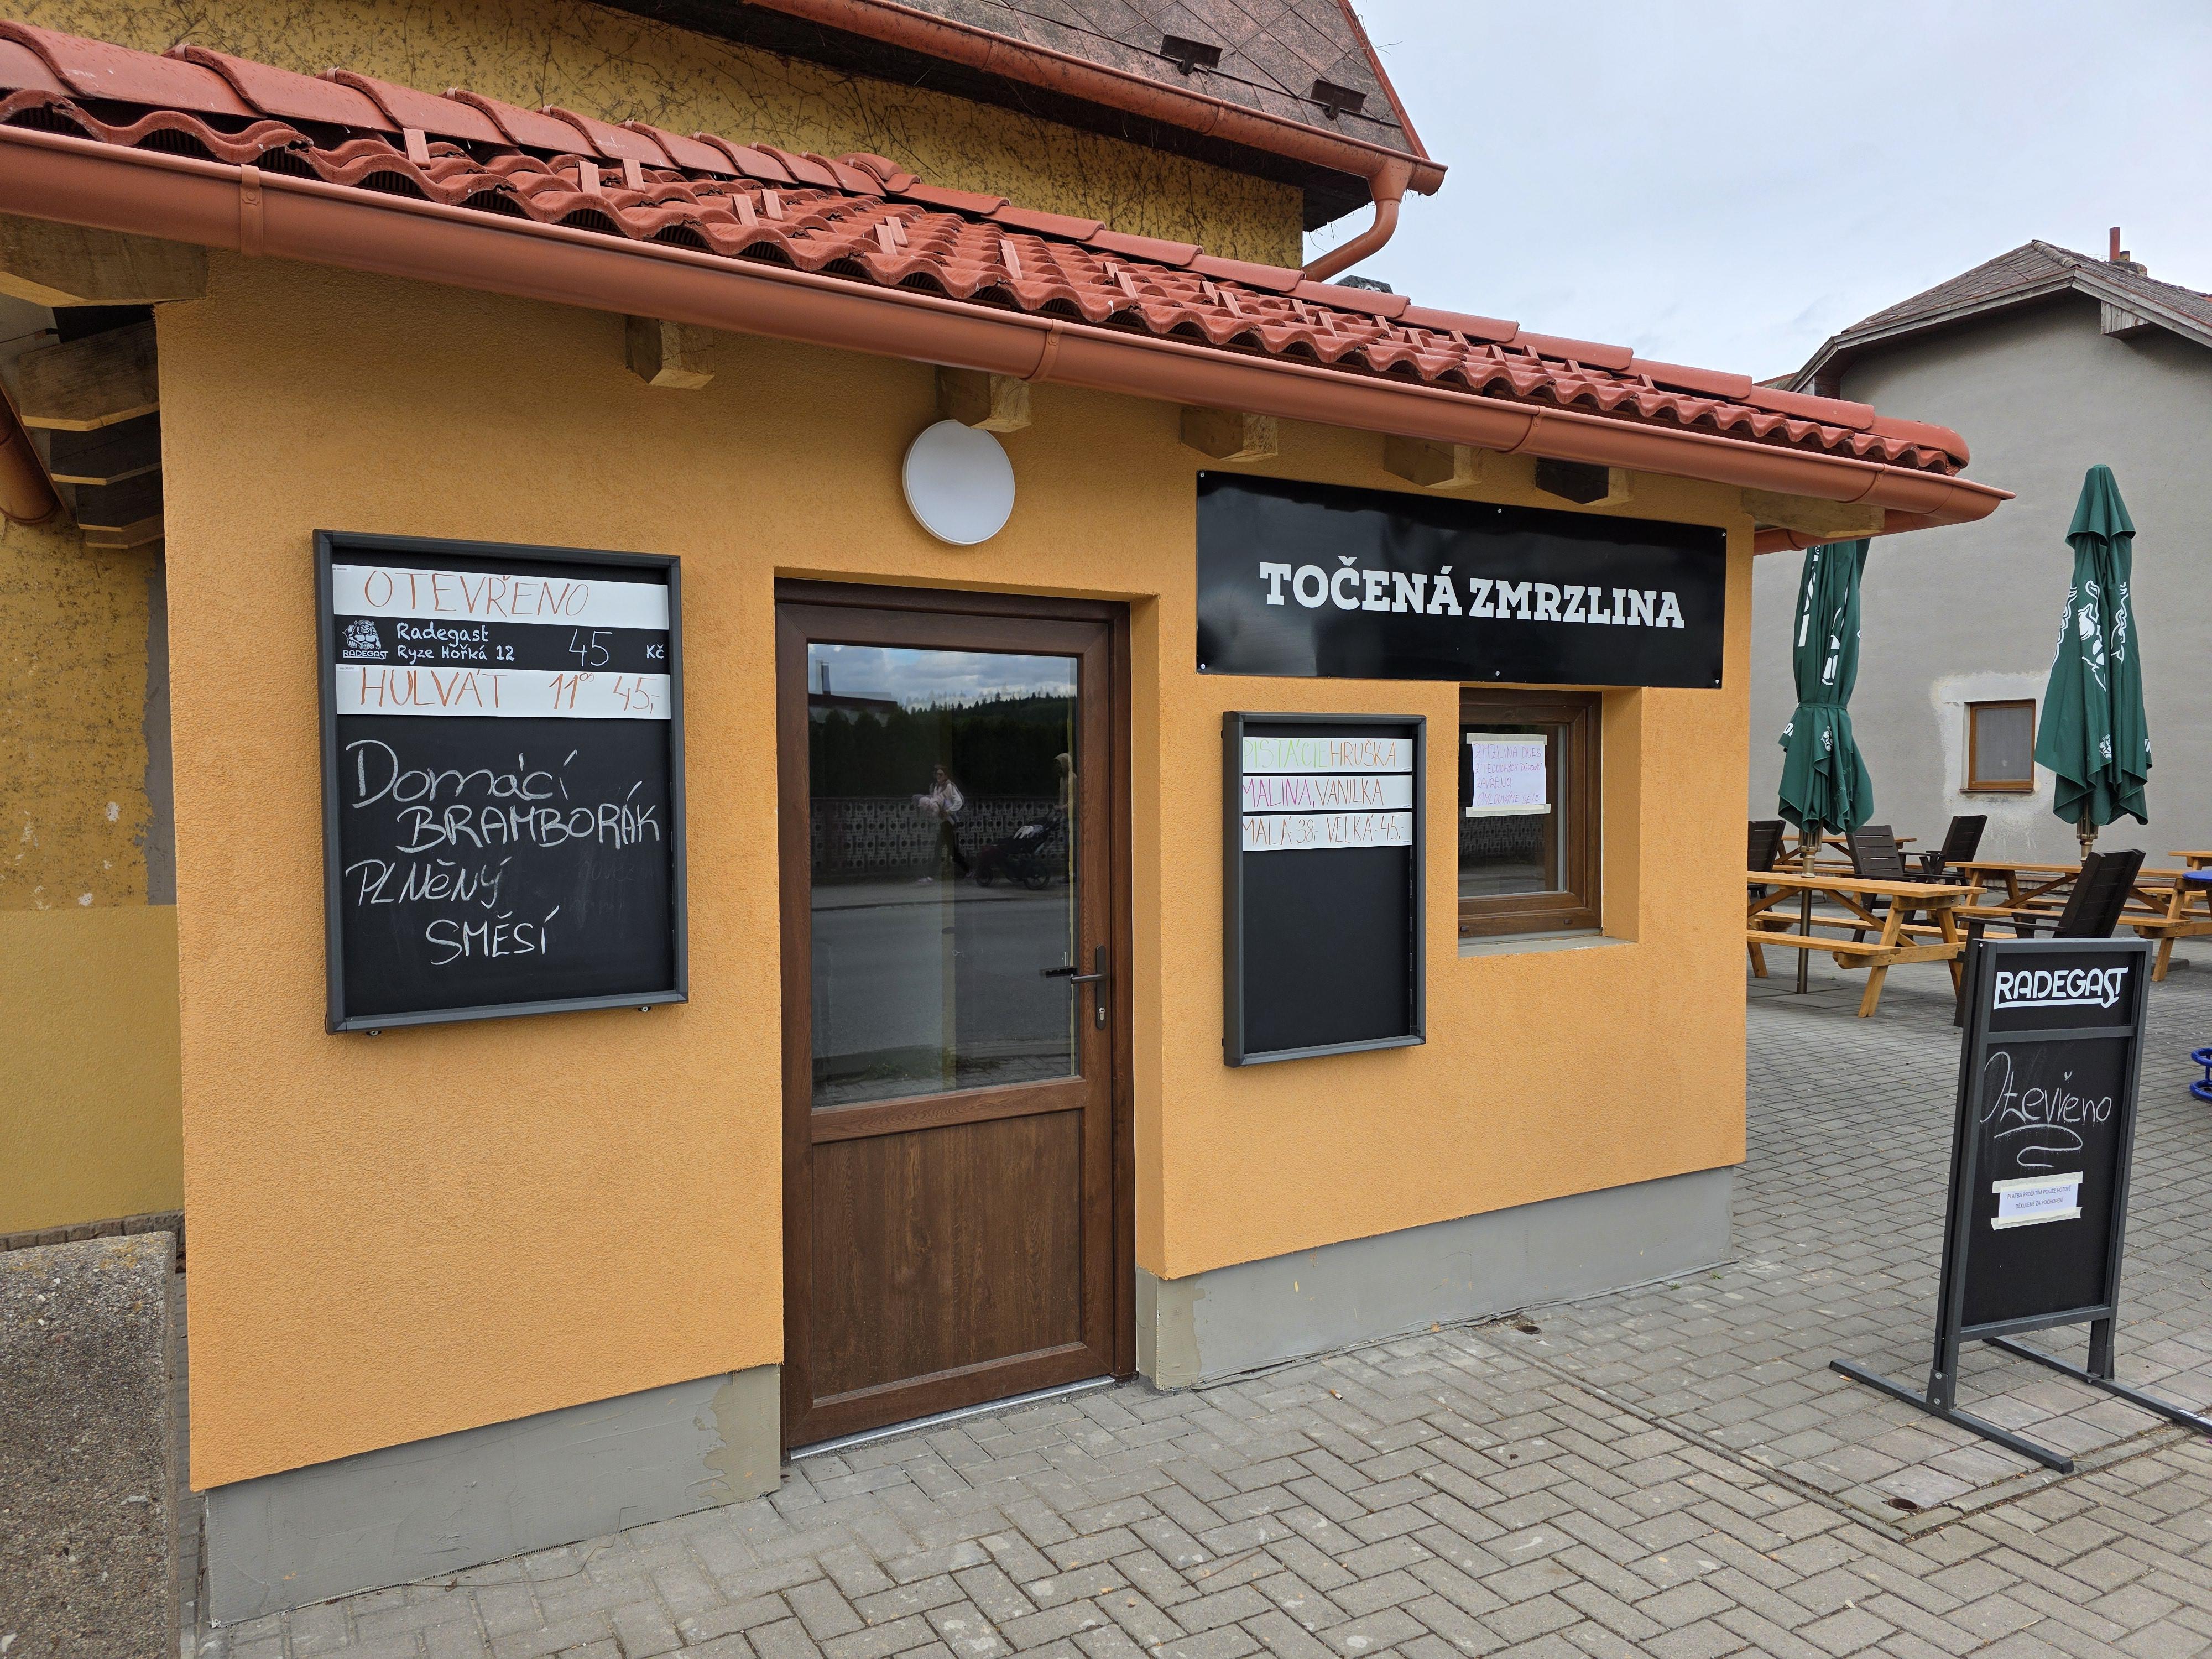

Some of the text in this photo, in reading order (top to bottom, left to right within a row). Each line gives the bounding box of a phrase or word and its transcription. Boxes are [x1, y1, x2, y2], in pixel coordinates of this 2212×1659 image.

[365, 570, 589, 617] OTEVŘENO
[1259, 555, 1685, 628] TOČENÁ ZMRZLINA
[397, 621, 488, 648] Radegast
[569, 629, 612, 667] 45
[646, 644, 664, 659] Kč
[342, 649, 388, 660] RADEGAST
[397, 644, 514, 665] Ryze Hořká 12
[361, 667, 508, 708] HULVÁT
[1330, 738, 1396, 768] HRUŠKA
[1315, 778, 1384, 806] VANILKA
[395, 780, 660, 853] BRAMBORÁK
[426, 906, 559, 965] SMĚSÍ
[1993, 967, 2129, 1010] RADEGAST
